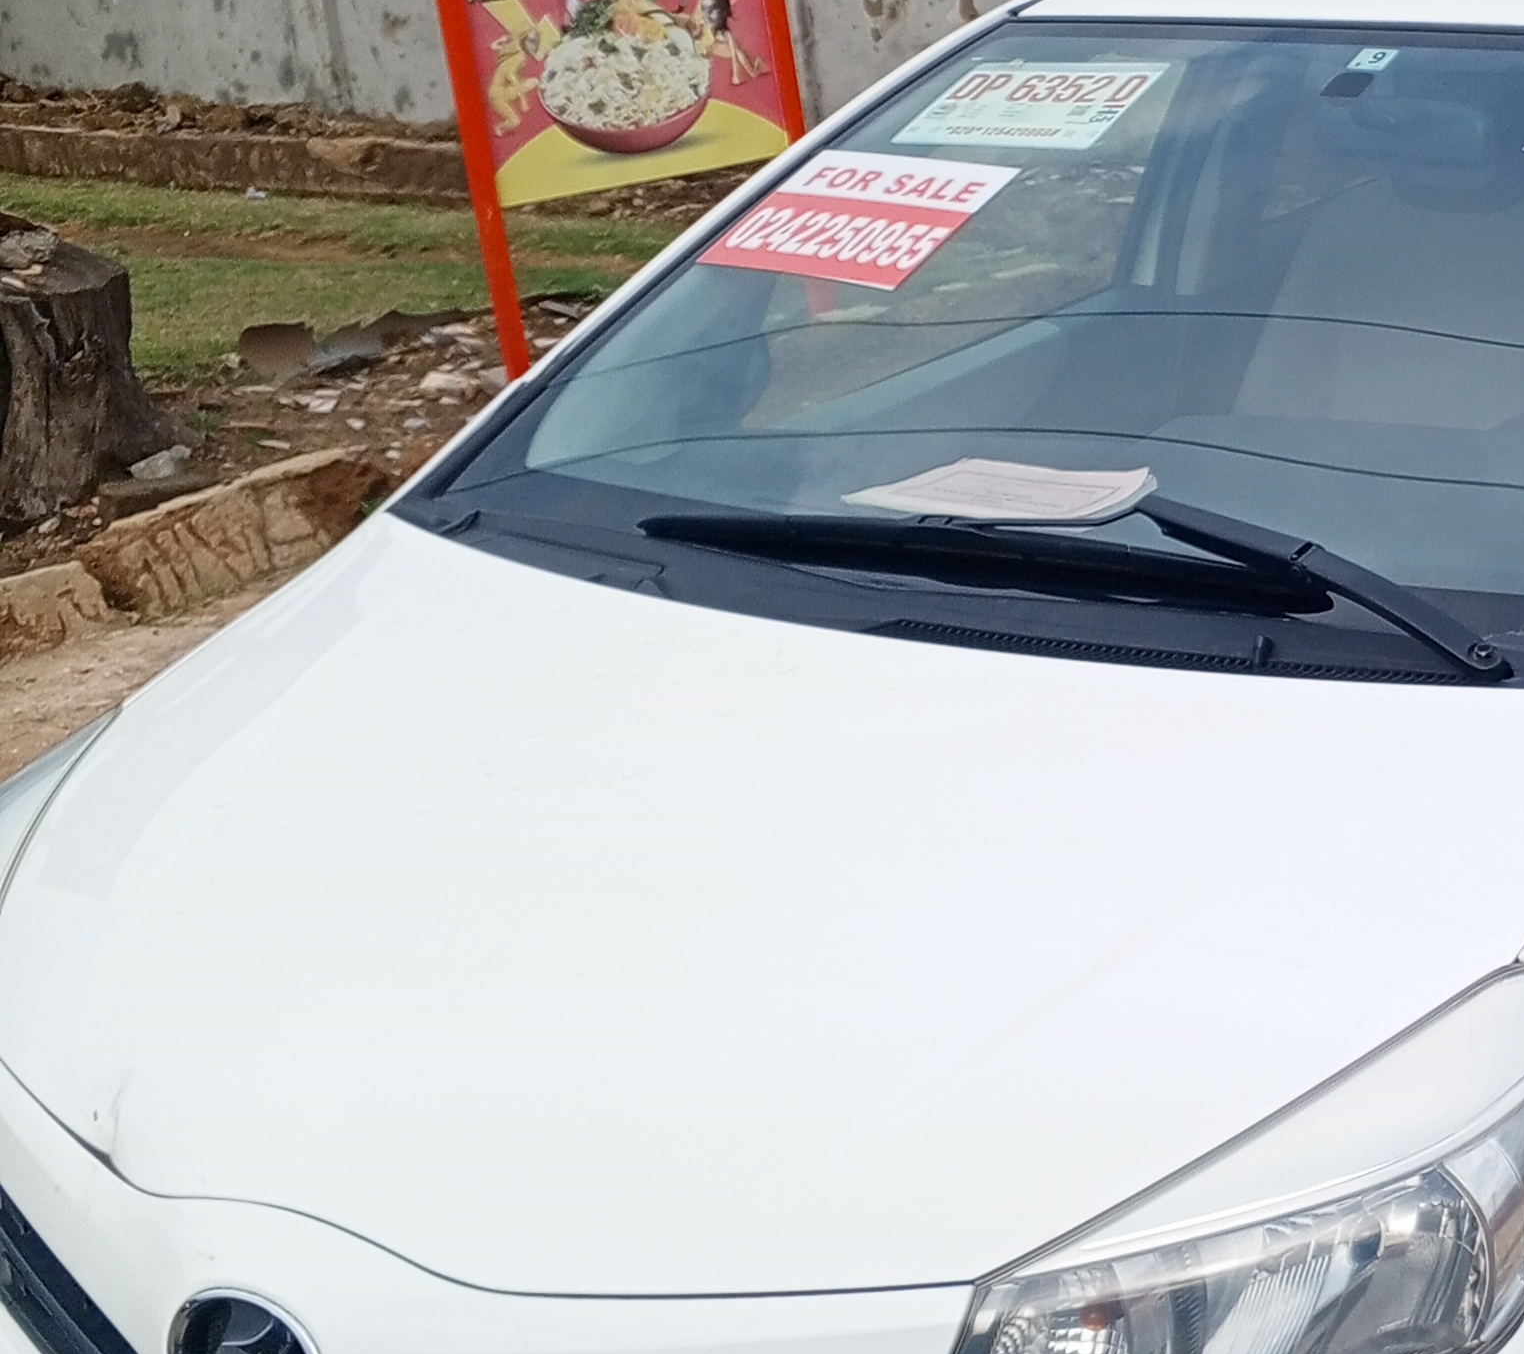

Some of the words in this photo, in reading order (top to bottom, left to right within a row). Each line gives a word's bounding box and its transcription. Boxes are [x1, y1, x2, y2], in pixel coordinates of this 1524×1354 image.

[946, 73, 1013, 101] DP
[1005, 74, 1117, 103] 6352
[803, 166, 884, 192] FOR
[883, 173, 987, 204] SALE
[725, 206, 952, 271] 0242250955
